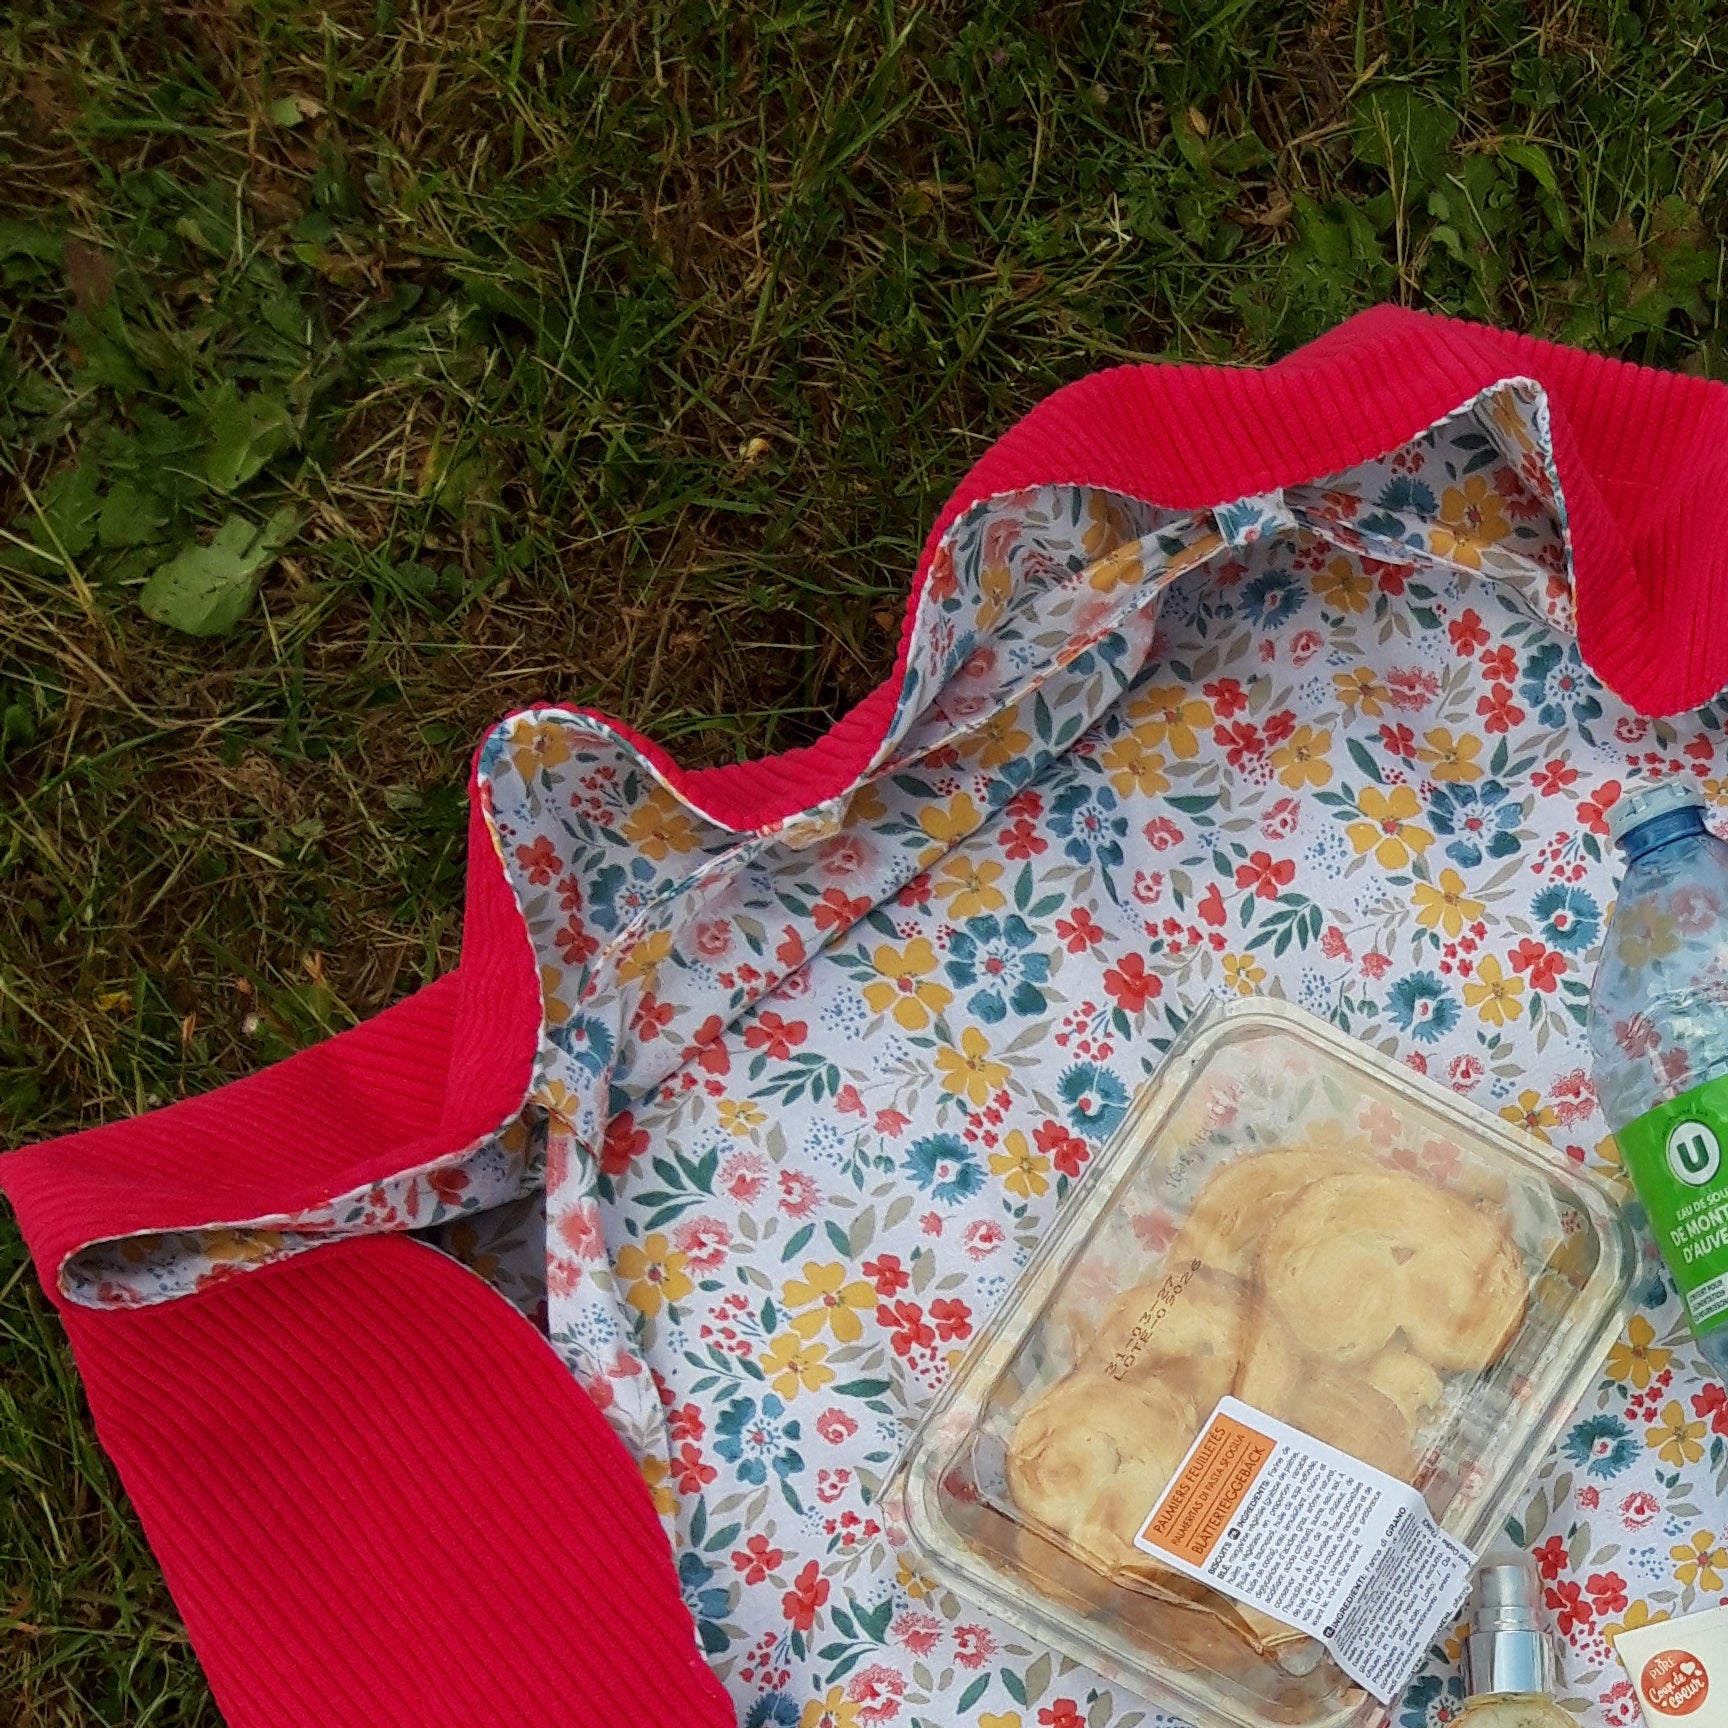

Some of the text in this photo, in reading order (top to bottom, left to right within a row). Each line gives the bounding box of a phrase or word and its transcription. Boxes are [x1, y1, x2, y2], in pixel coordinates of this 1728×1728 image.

[1677, 1135, 1710, 1173] U
[1676, 1207, 1693, 1220] EAU
[1694, 1198, 1707, 1213] DE
[1670, 1226, 1688, 1248] DE
[1218, 1432, 1246, 1468] SFOGLIA
[1151, 1423, 1227, 1535] PALMIERS FEUILLETÉS
[1203, 1465, 1225, 1492] PASTA
[1197, 1489, 1210, 1502] DI
[1649, 1656, 1678, 1680] PURE
[1649, 1671, 1687, 1703] Coup de
[1668, 1678, 1705, 1708] coeur
